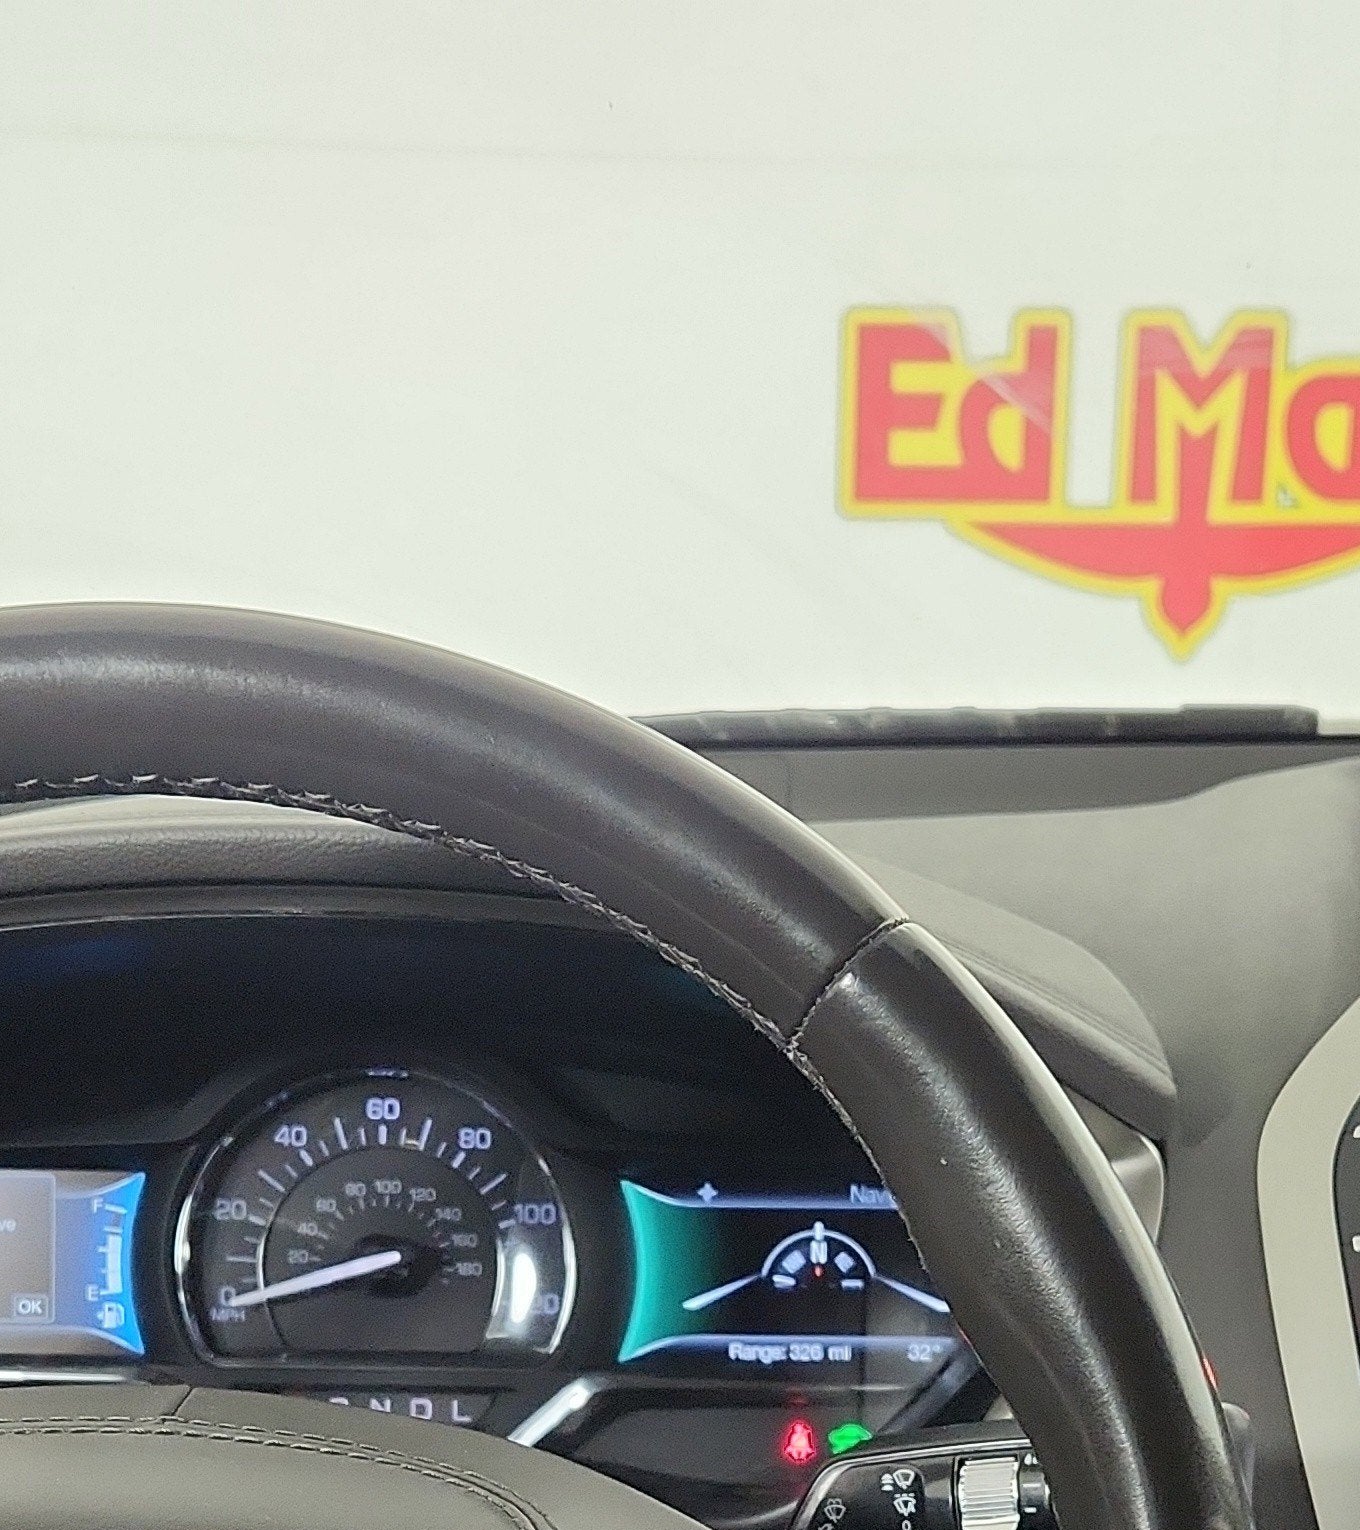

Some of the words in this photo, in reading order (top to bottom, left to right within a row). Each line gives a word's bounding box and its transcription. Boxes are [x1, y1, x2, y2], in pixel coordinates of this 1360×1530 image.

[844, 312, 1070, 518] Ed
[365, 1097, 402, 1121] 60
[273, 1125, 308, 1148] 40
[457, 1127, 492, 1150] 80
[372, 1180, 403, 1197] 100
[92, 1199, 104, 1214] F
[214, 1198, 249, 1222] 20
[514, 1203, 558, 1225] 100
[811, 1238, 828, 1264] N
[85, 1284, 99, 1301] E
[220, 1285, 238, 1306] 0
[17, 1299, 43, 1315] OK
[208, 1308, 247, 1323] MPH
[727, 1340, 788, 1365] Range:
[788, 1341, 825, 1363] 326
[451, 1399, 473, 1423] L
